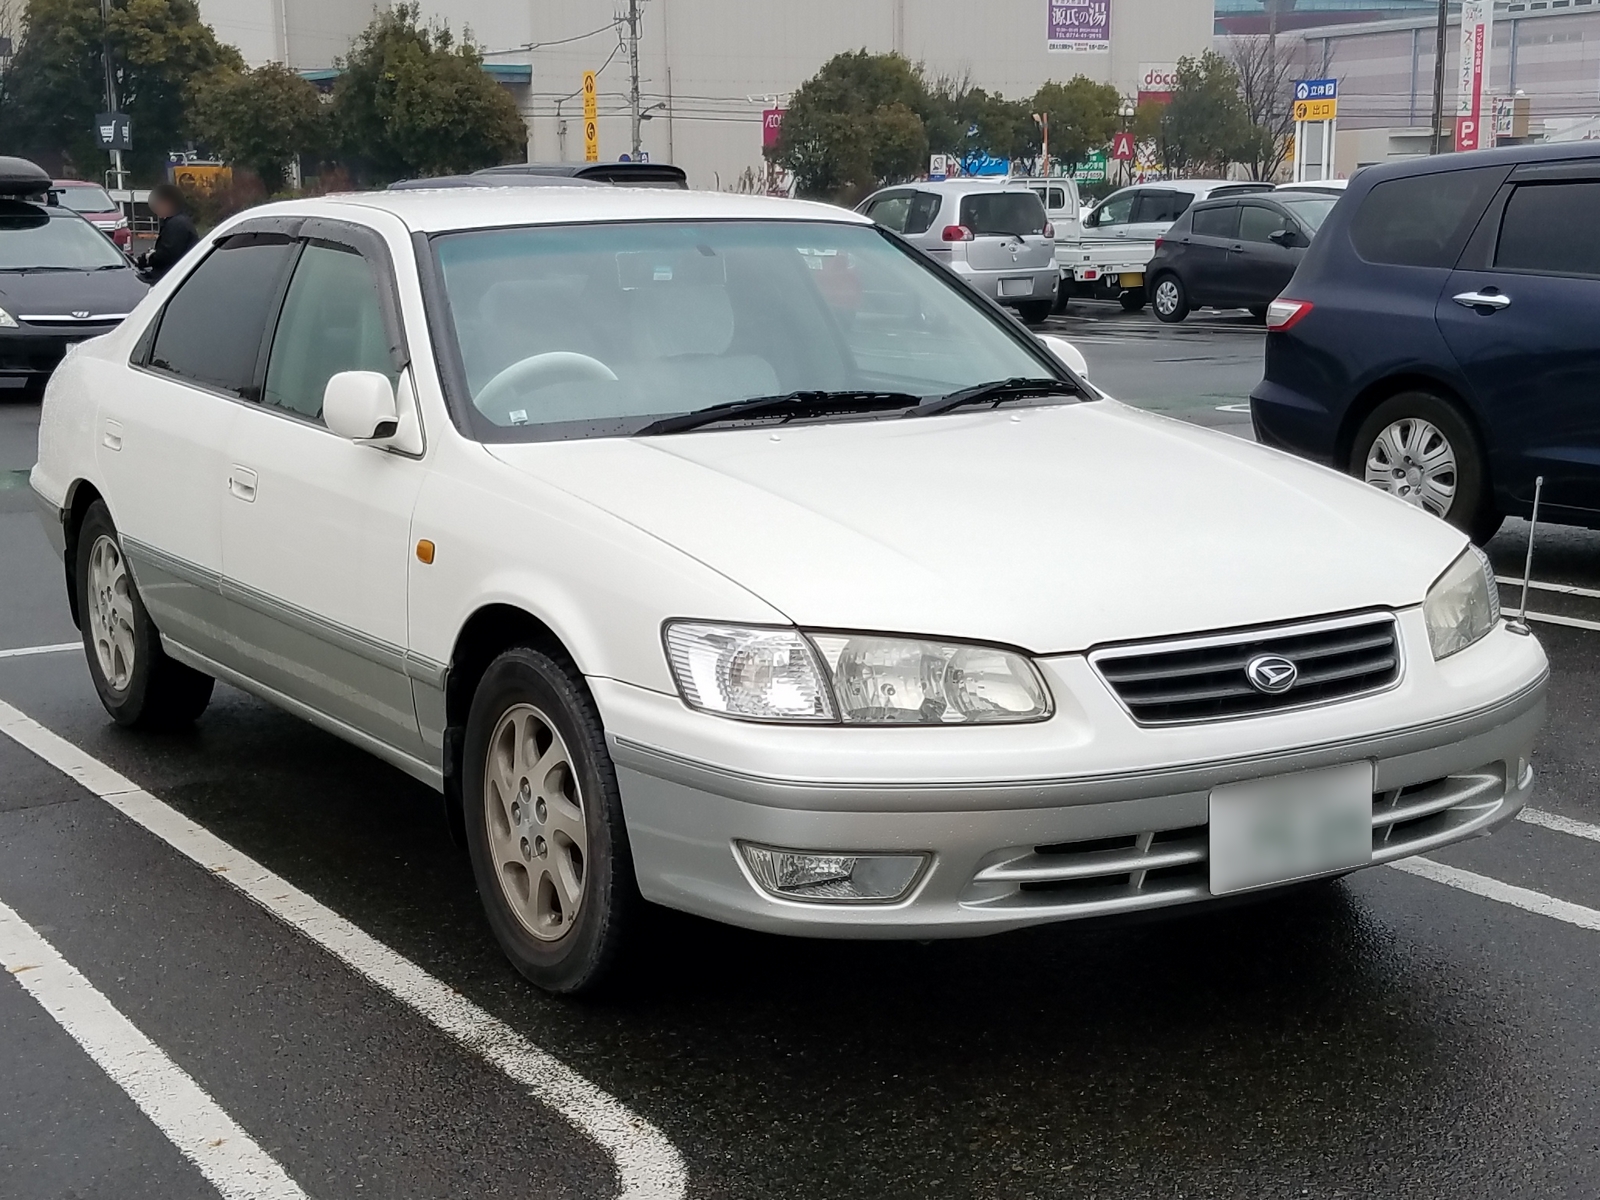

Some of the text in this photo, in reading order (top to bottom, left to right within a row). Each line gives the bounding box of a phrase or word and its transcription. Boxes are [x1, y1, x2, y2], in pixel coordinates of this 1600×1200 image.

[1052, 2, 1107, 27] 源氏の湯
[1145, 69, 1179, 85] doco
[1313, 105, 1329, 115] 出口
[1461, 121, 1474, 138] P
[1117, 138, 1129, 155] A
